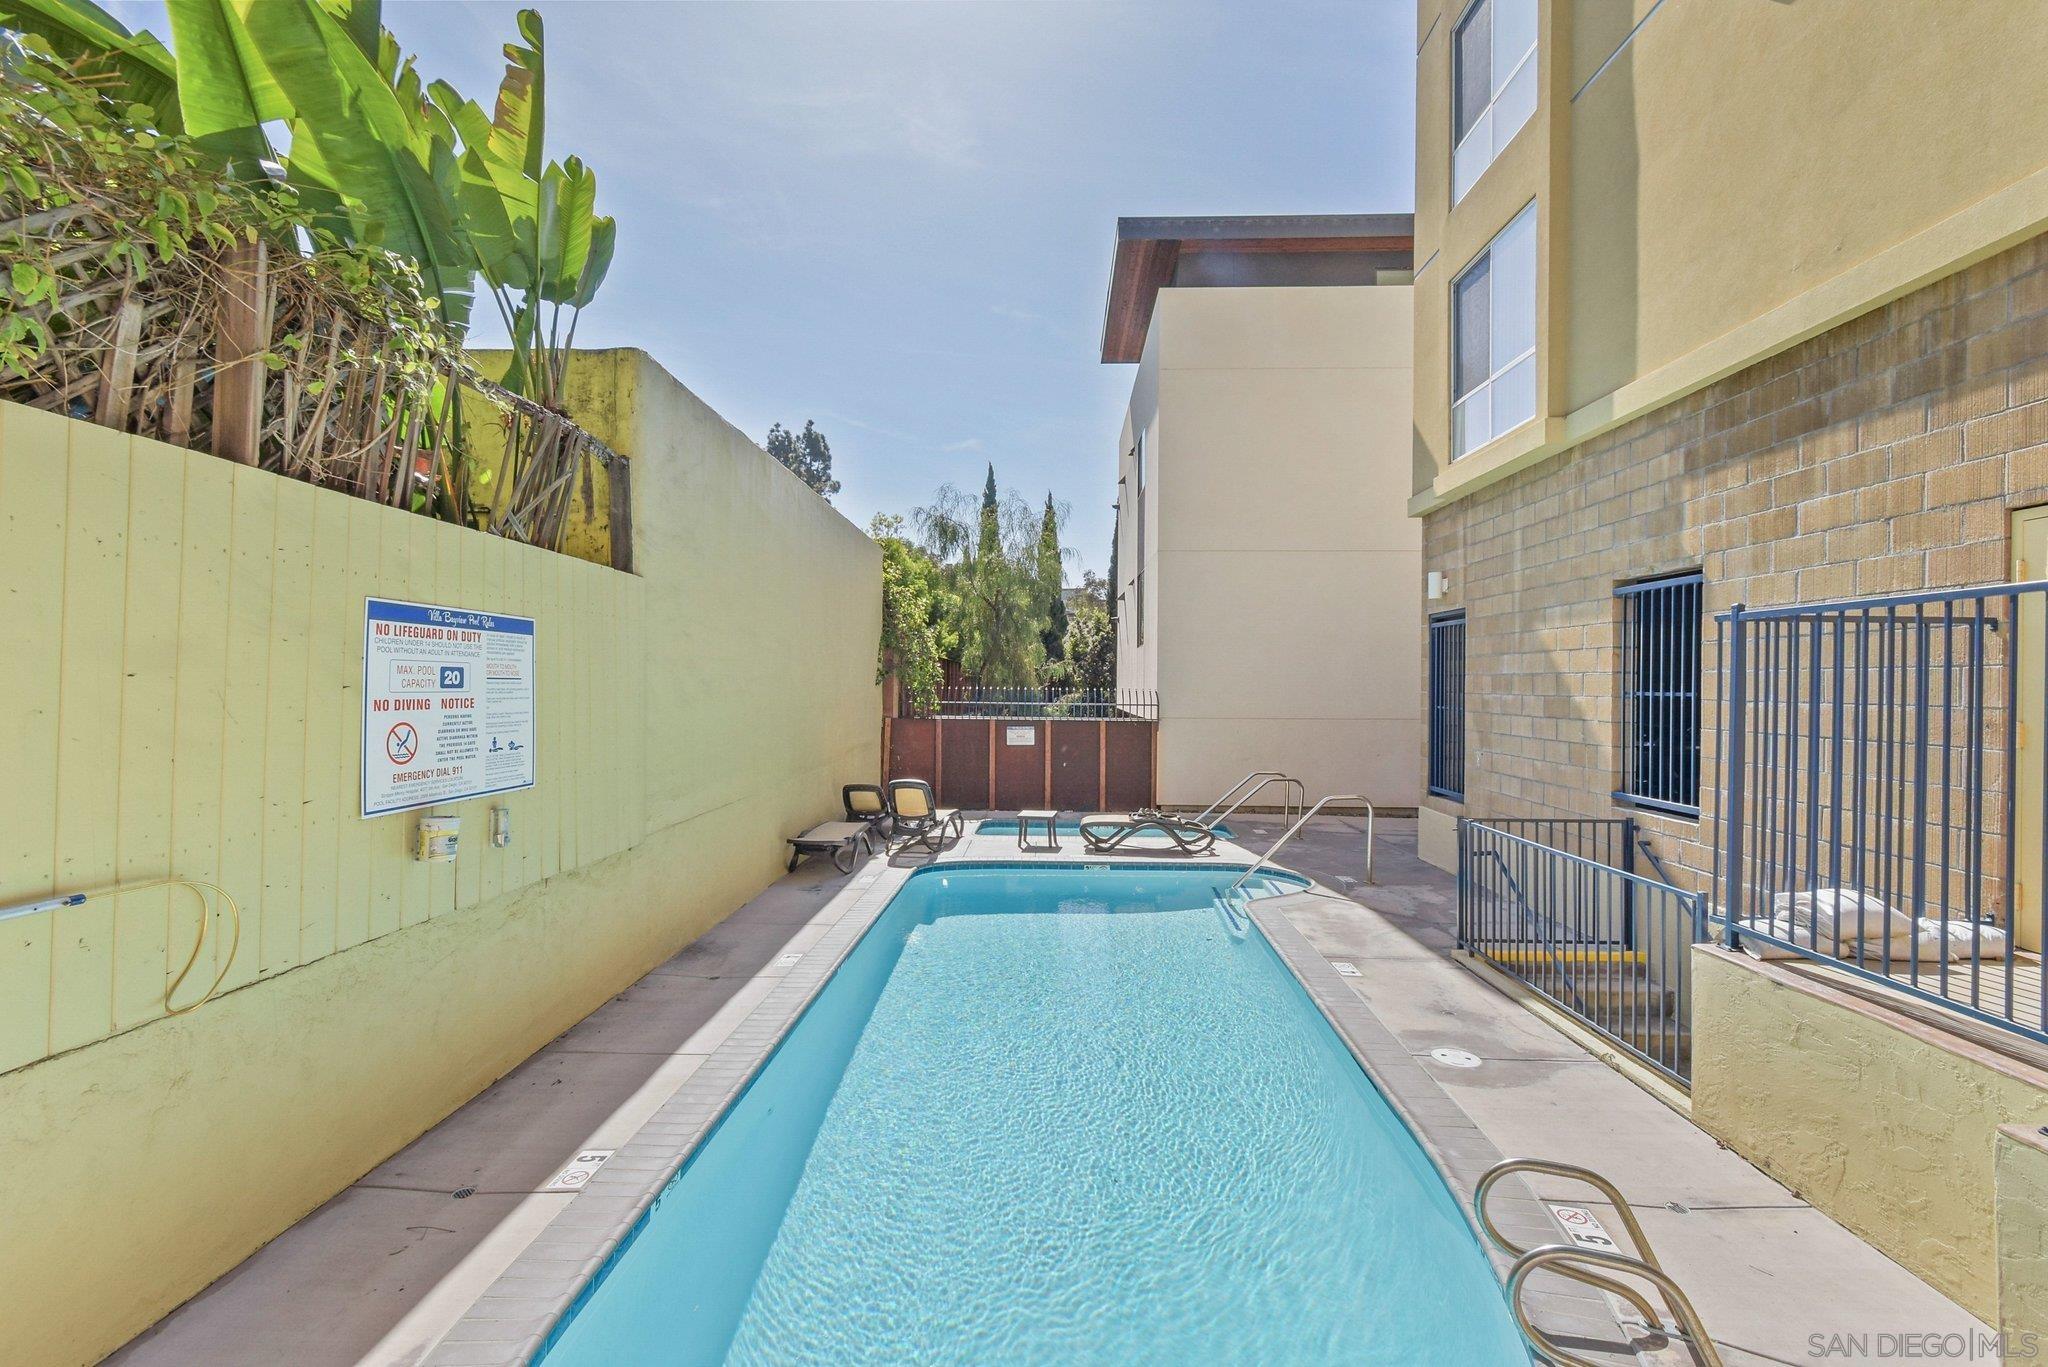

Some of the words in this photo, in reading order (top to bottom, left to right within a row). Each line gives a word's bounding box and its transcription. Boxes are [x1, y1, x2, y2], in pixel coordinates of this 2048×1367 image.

[468, 614, 480, 626] Pool
[376, 623, 390, 636] NO
[394, 625, 444, 640] LIFEGUARD
[447, 630, 458, 640] ON
[462, 632, 482, 642] DUTY
[374, 637, 404, 646] CHILDREN
[396, 665, 414, 675] MAX.
[418, 666, 436, 675] POOL
[444, 670, 460, 685] 20
[402, 679, 436, 688] CAPACITY
[373, 700, 389, 711] NO
[394, 699, 430, 711] DIVING
[441, 698, 475, 709] NOTICE
[393, 769, 435, 783] EMERGENCY
[436, 767, 450, 777] DIAL
[452, 766, 463, 775] 911
[1573, 1234, 1612, 1245] 5
